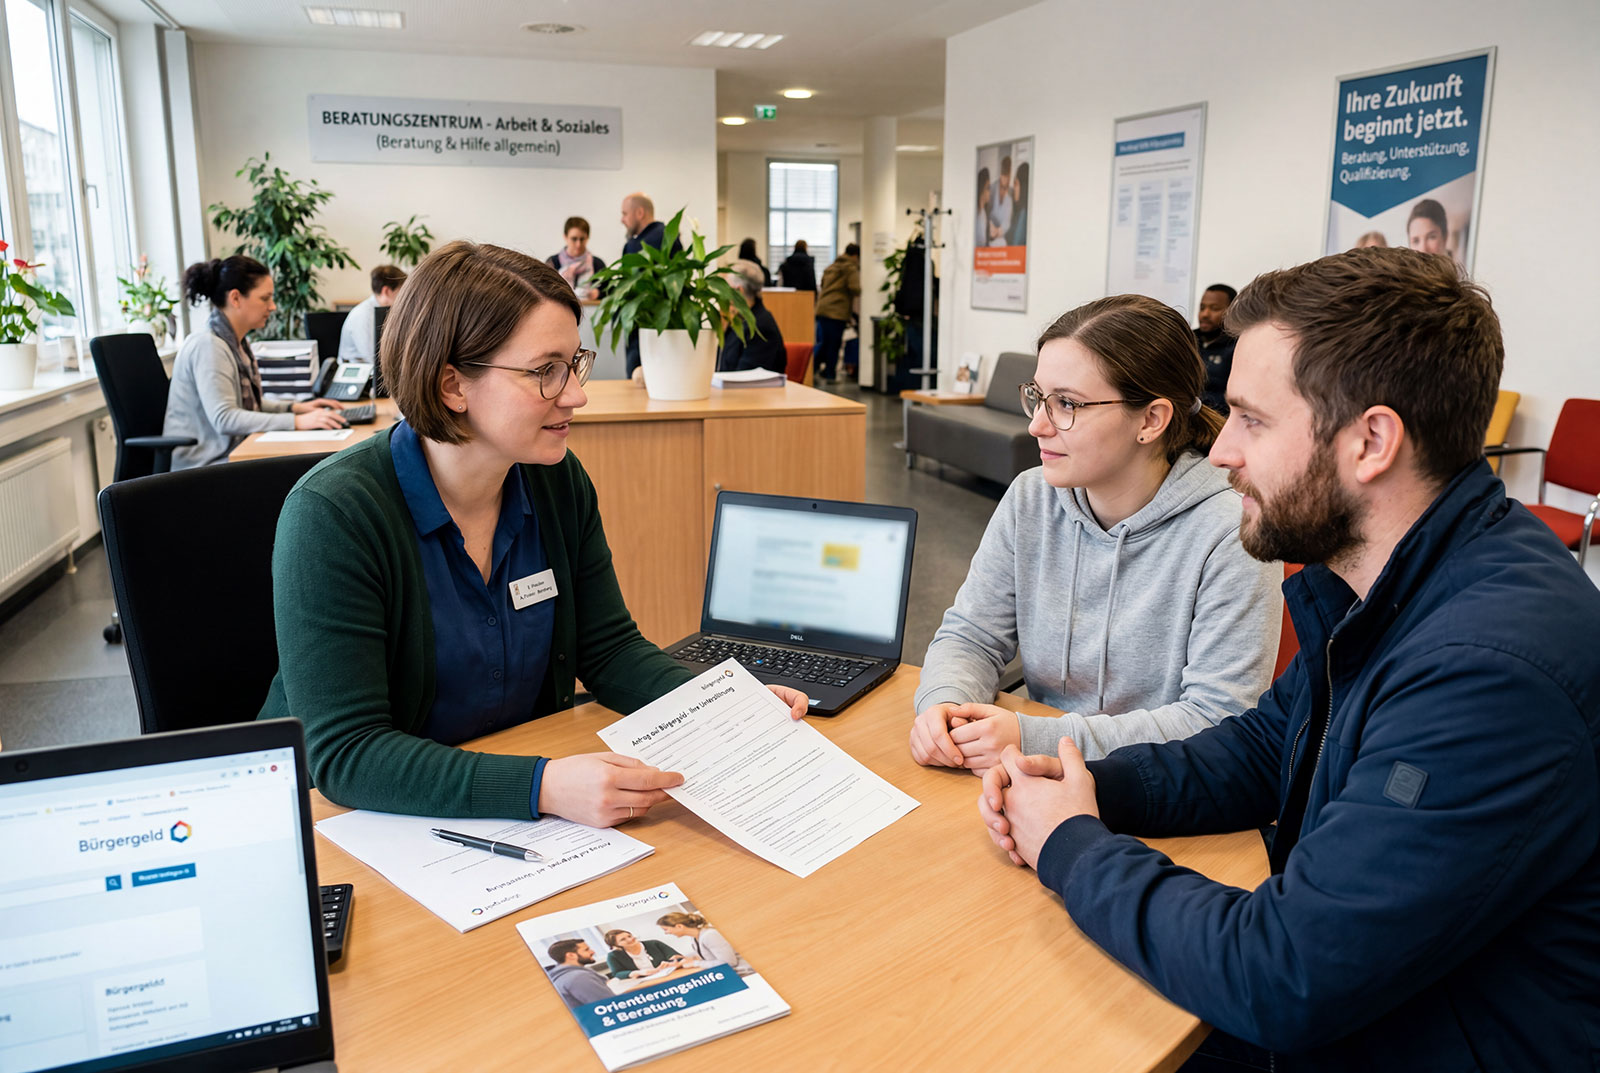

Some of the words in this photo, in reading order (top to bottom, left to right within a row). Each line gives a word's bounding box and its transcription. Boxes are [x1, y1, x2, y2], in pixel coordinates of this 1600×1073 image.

[1345, 91, 1381, 114] Ihre
[1384, 73, 1464, 109] Zukunft
[322, 110, 484, 131] BERATUNGSZENTRUM
[495, 116, 538, 133] Arbeit
[541, 119, 553, 132] &
[556, 119, 610, 135] Soziales
[1343, 113, 1414, 145] beginnt
[1414, 105, 1469, 139] jetzt.
[376, 134, 442, 153] (Beratung
[446, 137, 458, 151] &
[460, 137, 491, 152] Hilfe
[494, 139, 561, 156] allgemein)
[1339, 166, 1412, 185] Qualifizierung.
[78, 828, 164, 855] Bürgergeld
[593, 970, 725, 1016] Orientierungshilfe
[602, 1015, 617, 1028] &
[616, 996, 688, 1023] Beratung
